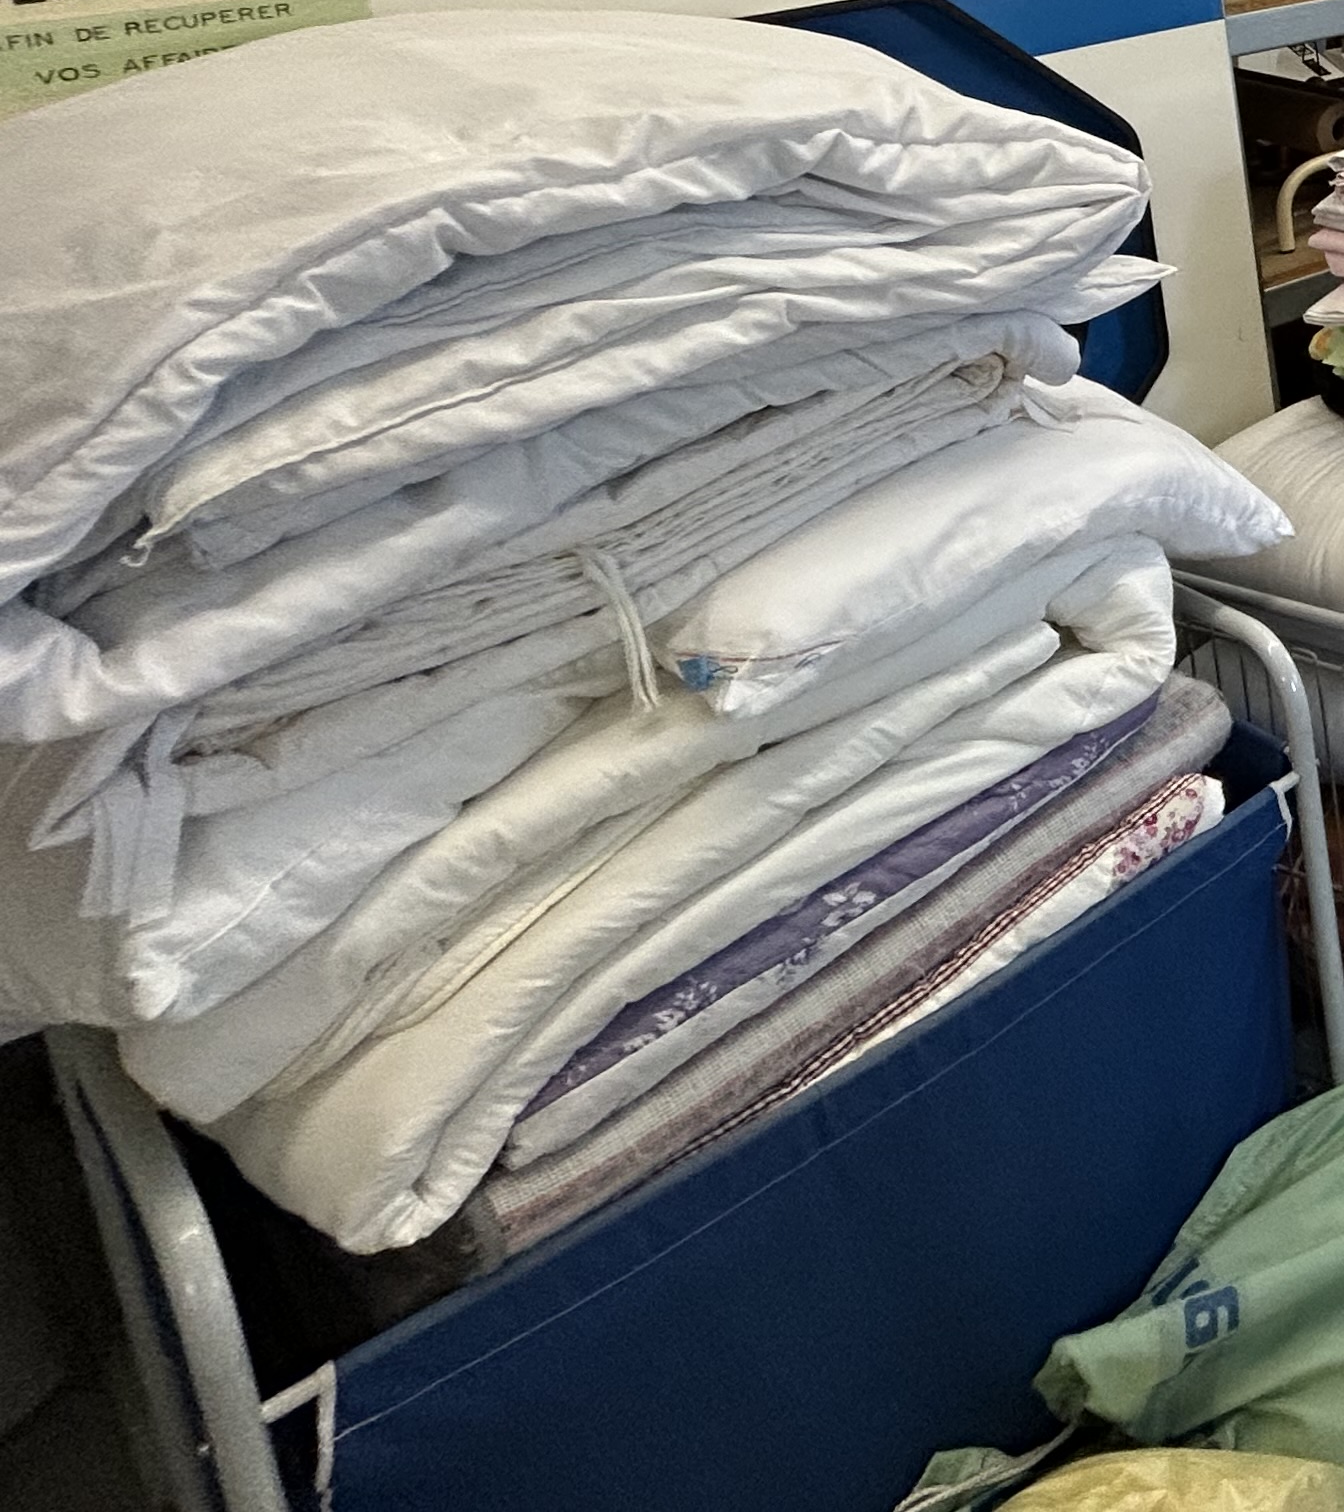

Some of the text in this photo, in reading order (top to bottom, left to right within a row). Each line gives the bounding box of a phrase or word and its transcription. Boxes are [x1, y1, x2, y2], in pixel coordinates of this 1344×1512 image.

[0, 2, 293, 50] FIN DE RECUPERER
[35, 62, 101, 85] VOS
